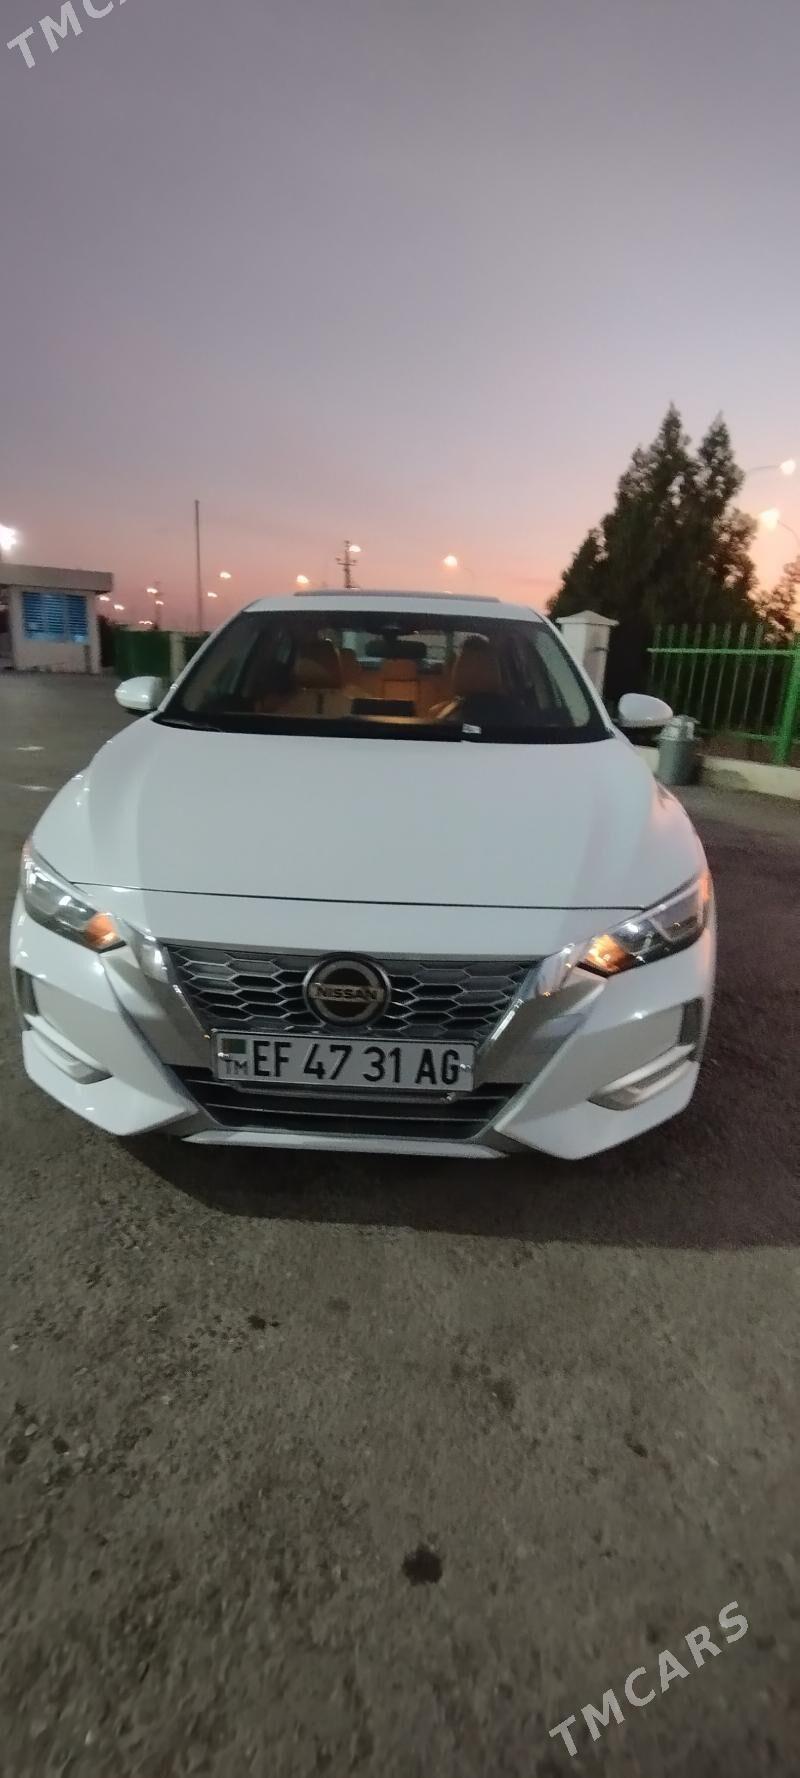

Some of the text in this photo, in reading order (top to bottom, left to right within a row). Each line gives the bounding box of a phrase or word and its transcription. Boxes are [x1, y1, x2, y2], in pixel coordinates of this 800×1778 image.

[316, 987, 378, 1001] NISSAN
[224, 1058, 248, 1075] TM
[253, 1040, 460, 1085] EF 47 31 AG
